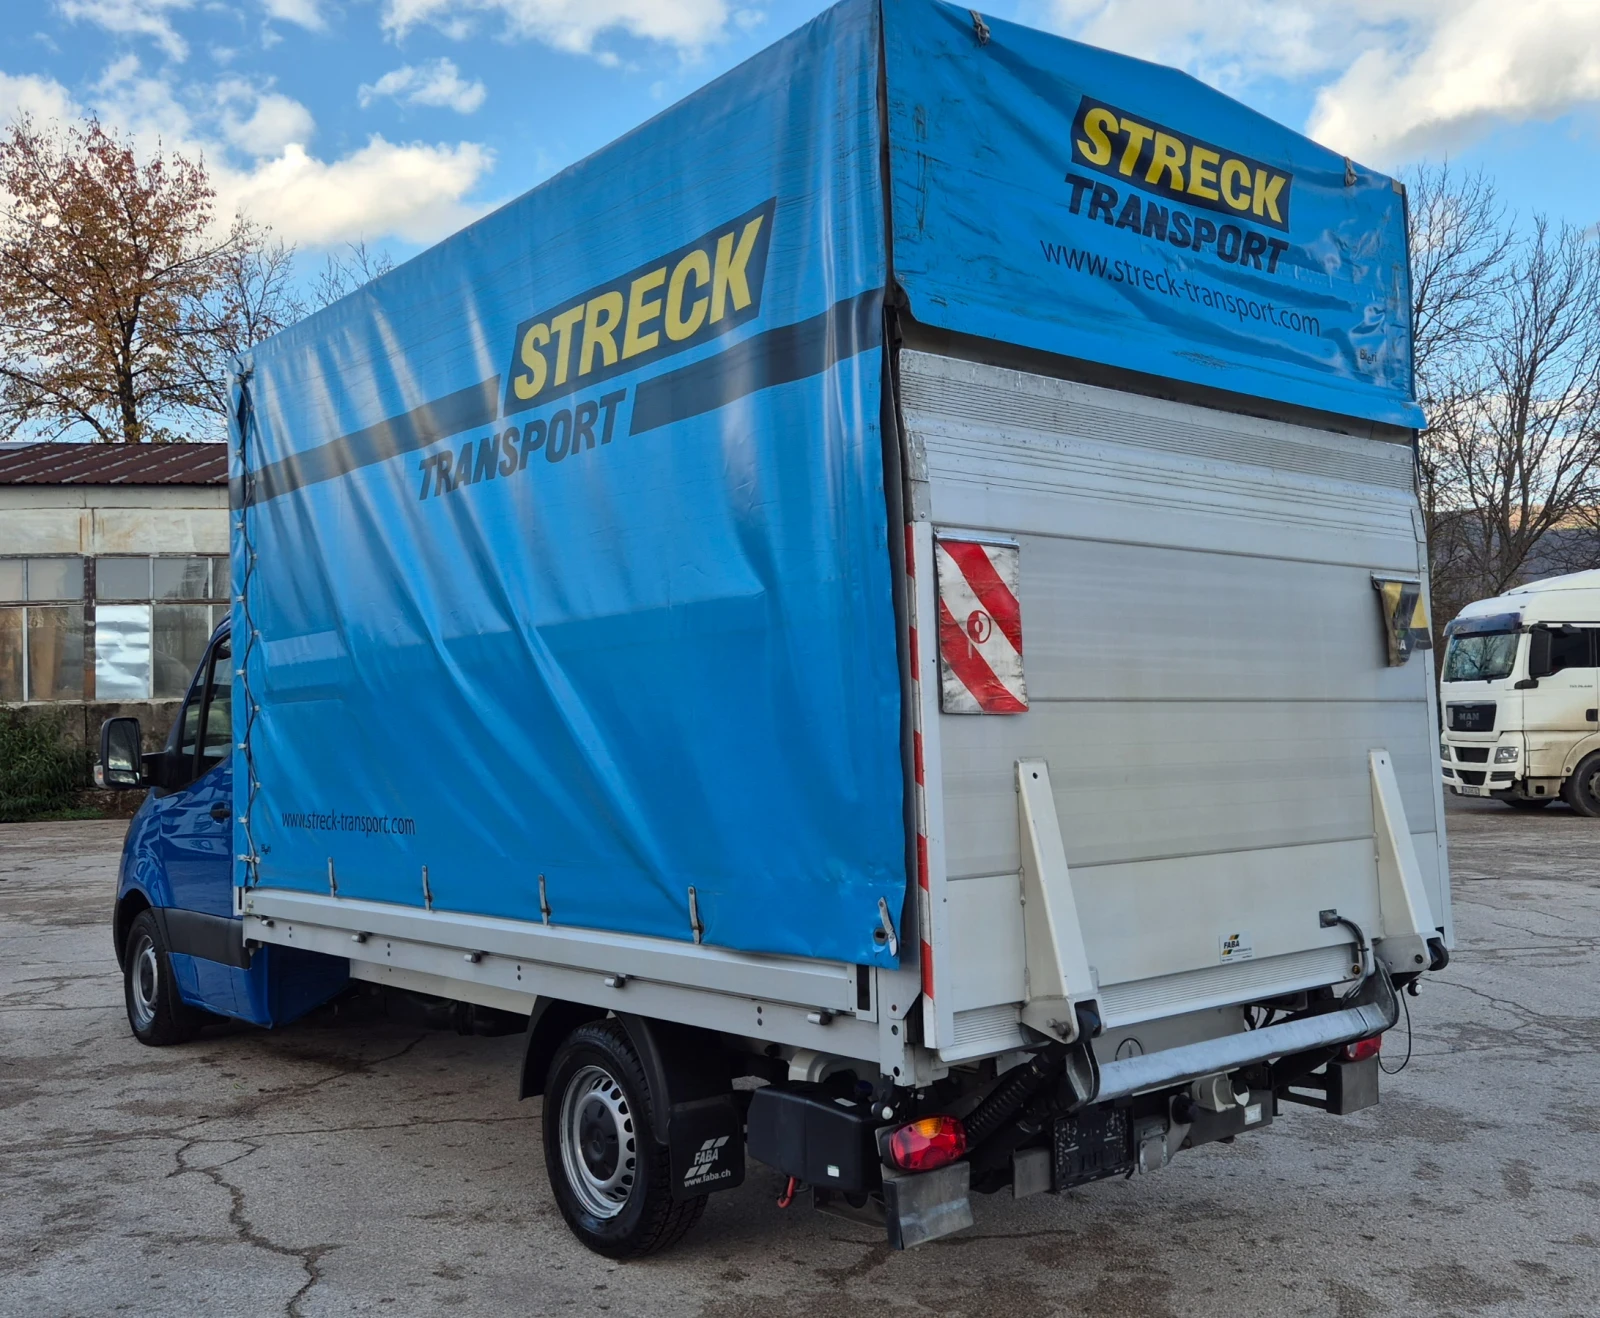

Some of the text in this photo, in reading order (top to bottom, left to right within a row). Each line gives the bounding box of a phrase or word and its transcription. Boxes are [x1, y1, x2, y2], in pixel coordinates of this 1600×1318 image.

[1076, 107, 1286, 224] STRECK
[1064, 173, 1289, 274] TRANSPORT
[514, 214, 764, 399] STRECK
[1040, 240, 1320, 337] www.streck-transport.com
[418, 387, 626, 500] TRANSPORT
[282, 808, 415, 838] www.streck-transport.com
[683, 1169, 731, 1188] www.faba.ch
[694, 1148, 719, 1166] FABA
